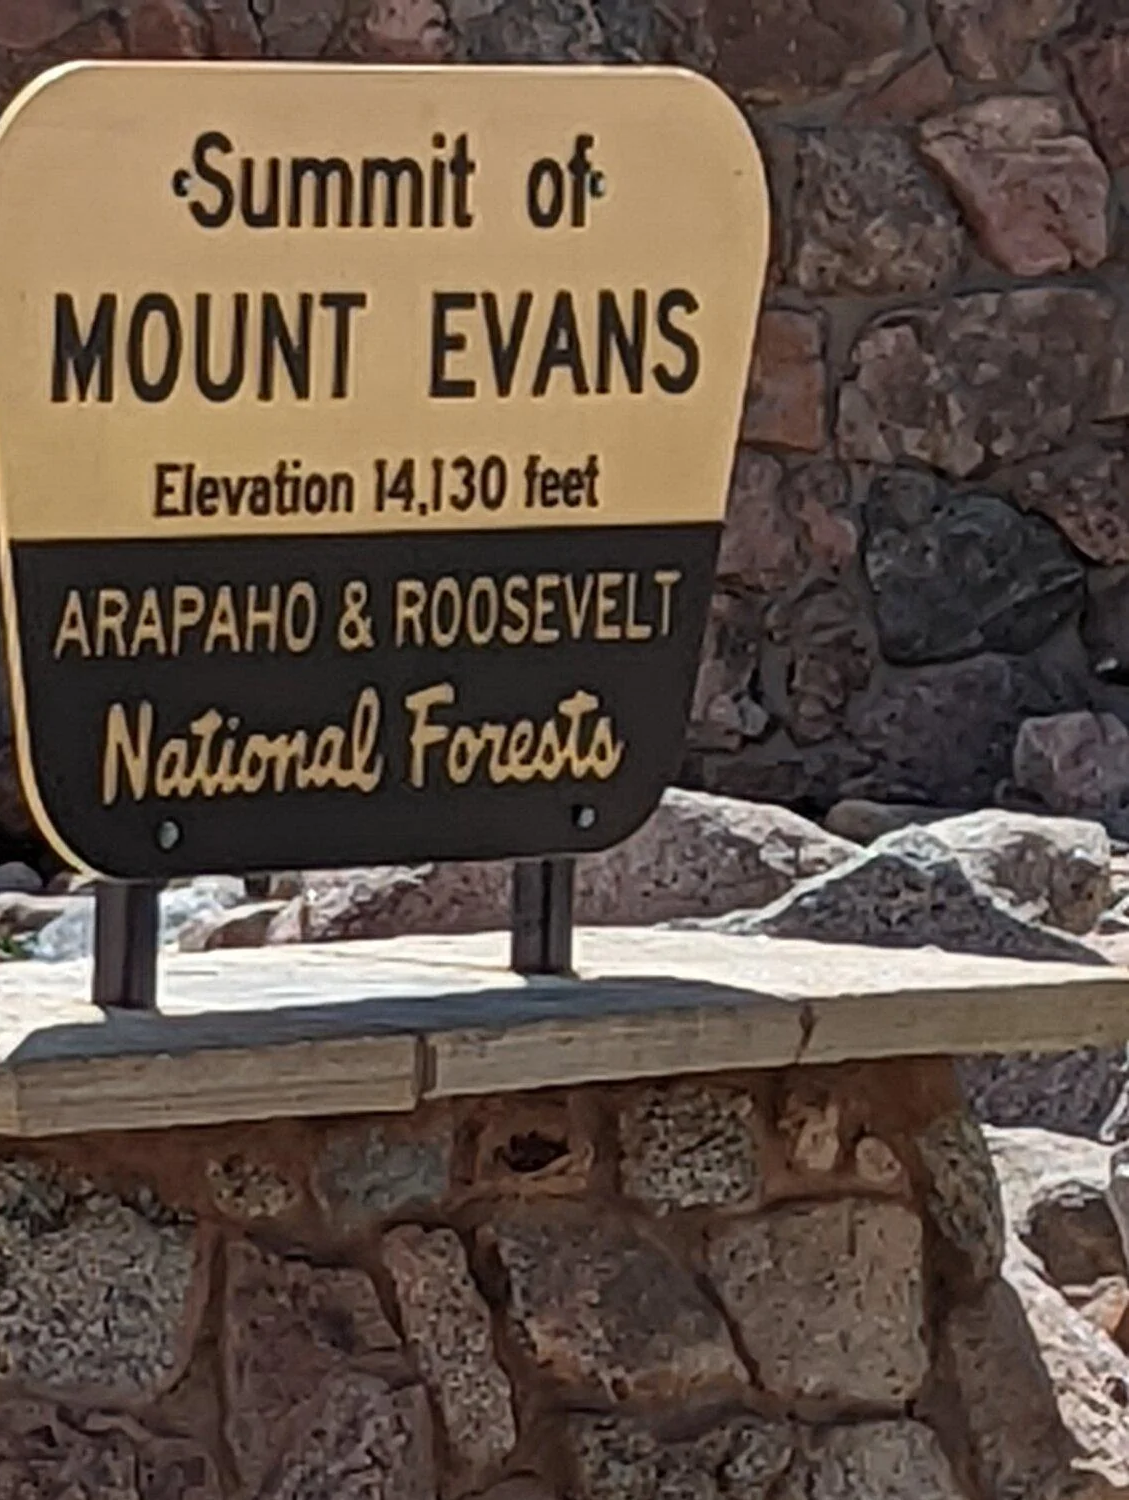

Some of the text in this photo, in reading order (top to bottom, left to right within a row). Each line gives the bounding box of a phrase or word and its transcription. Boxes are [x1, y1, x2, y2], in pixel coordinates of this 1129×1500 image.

[188, 130, 597, 229] Summit of
[51, 288, 700, 402] MOUNT EVANS
[153, 453, 600, 518] Elevation 14,130 feet
[54, 569, 682, 660] ARAPAHO & ROOSEVELT
[102, 682, 626, 805] National Forests
